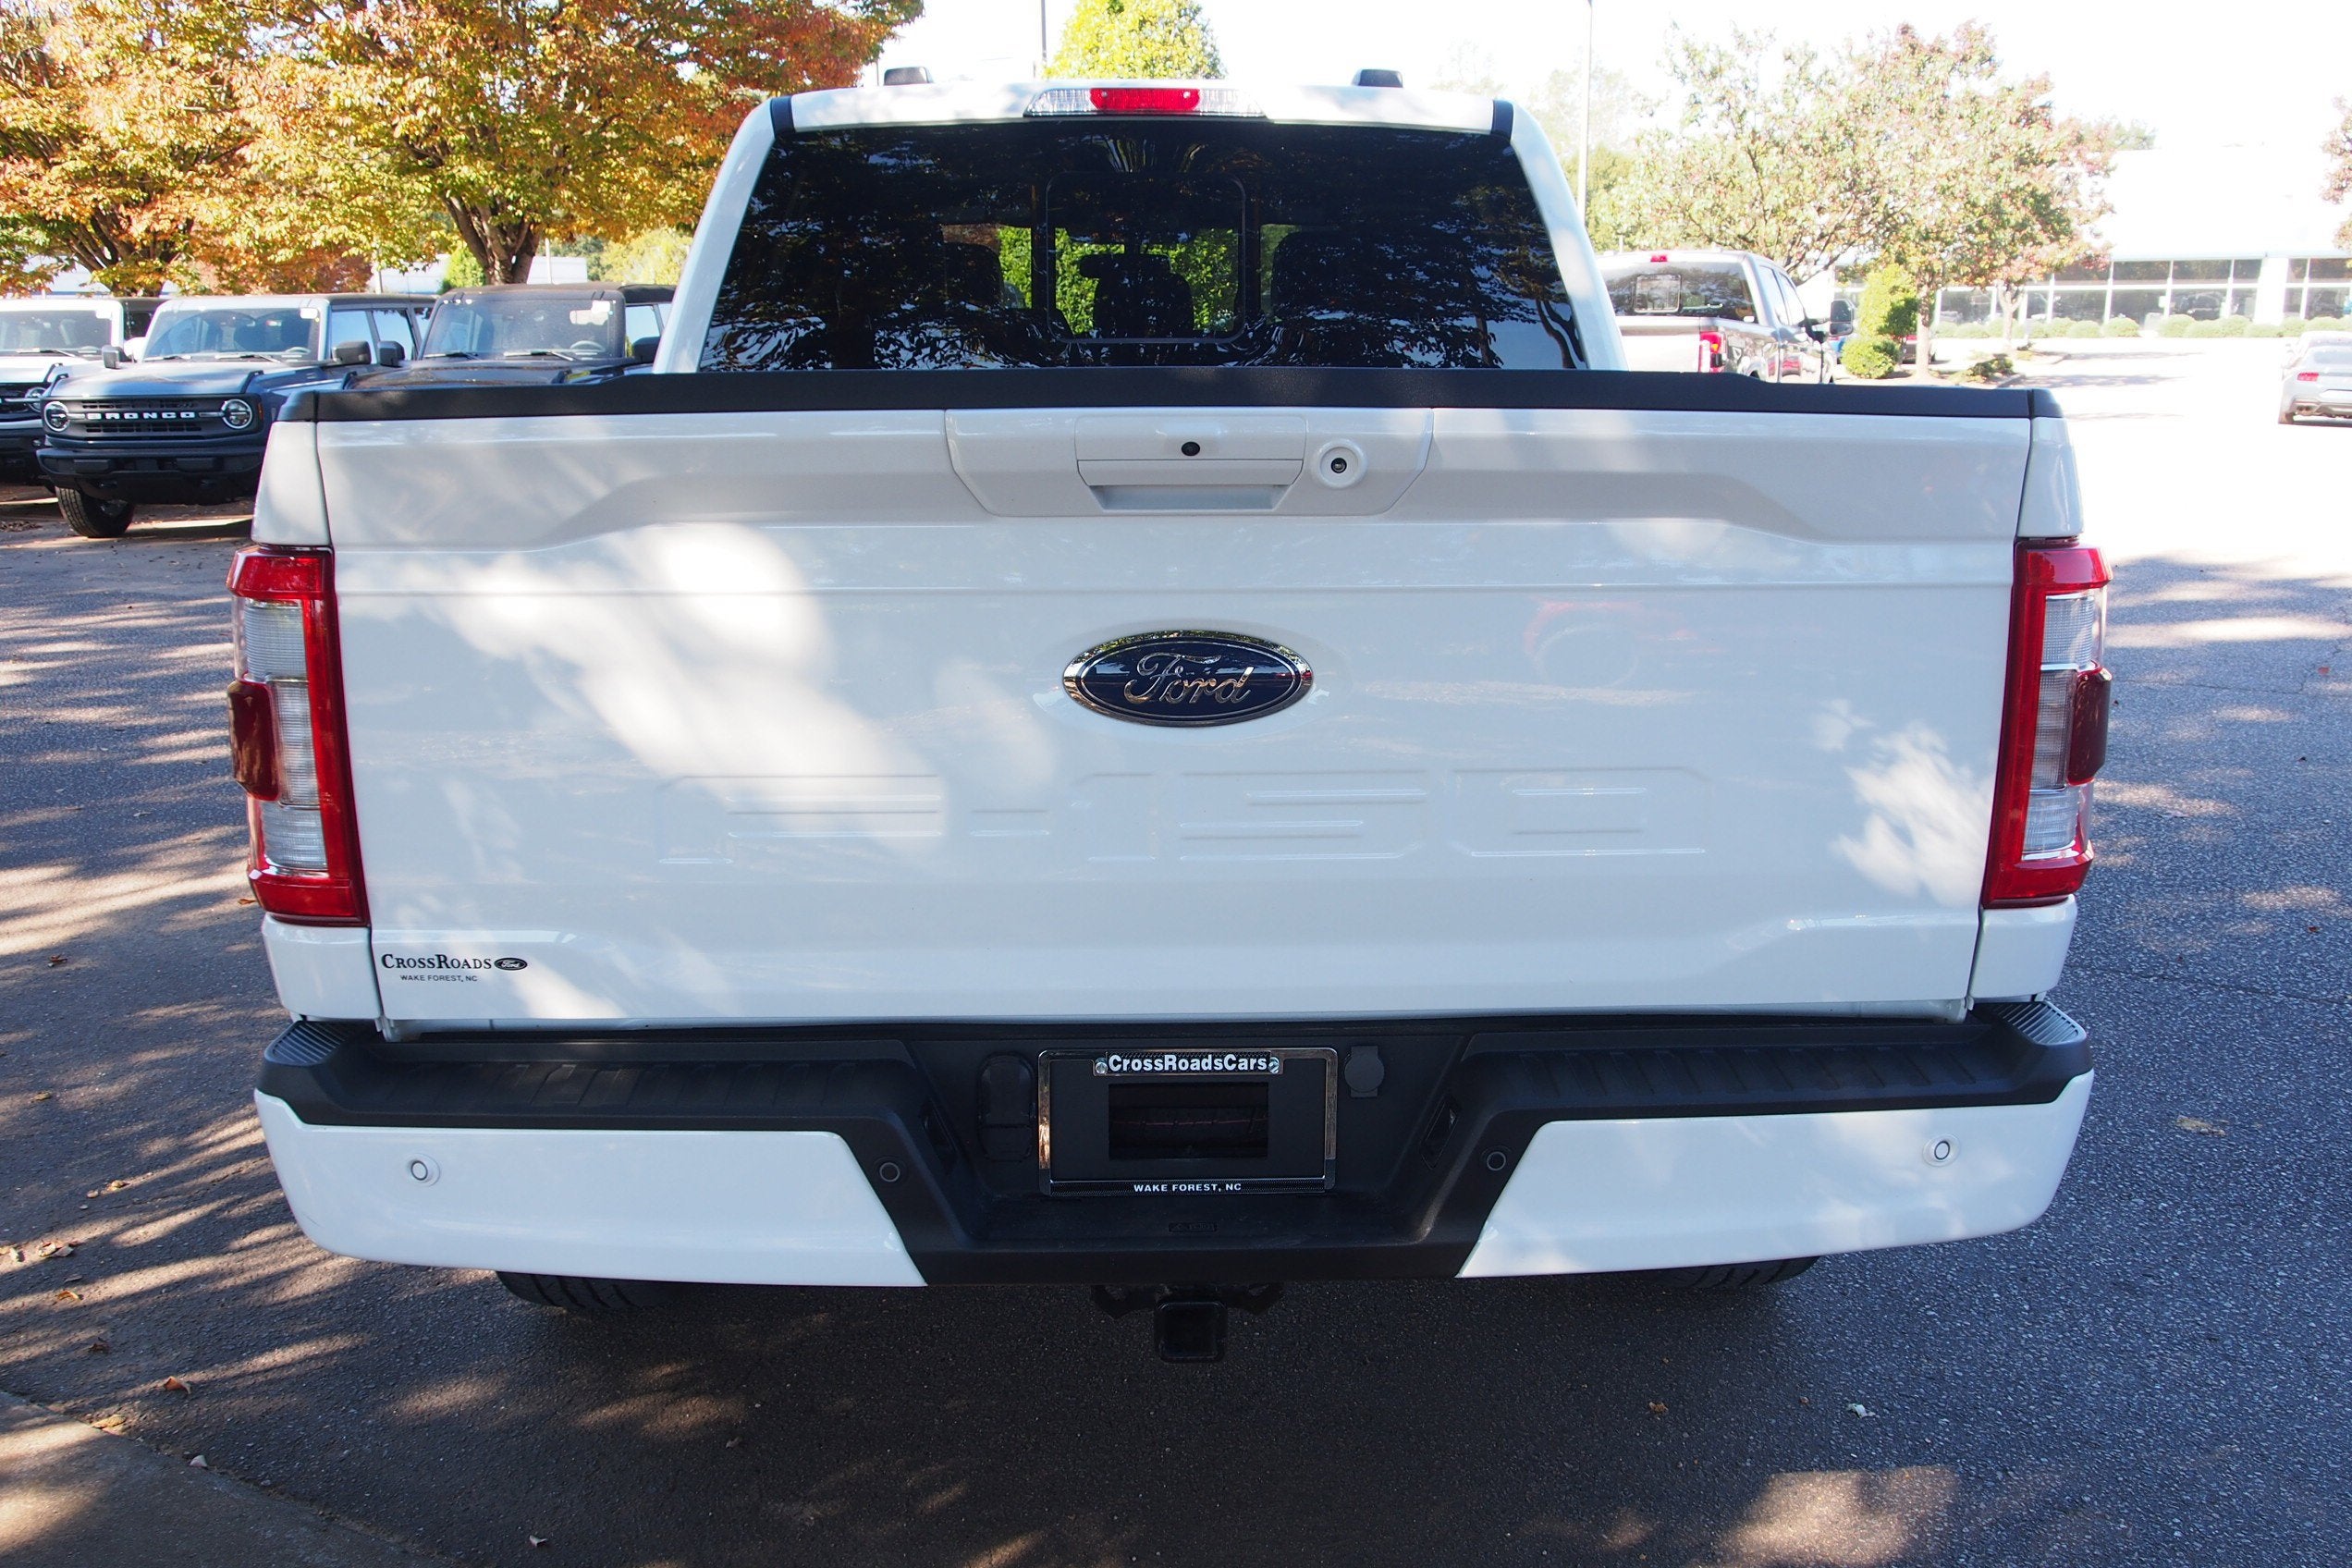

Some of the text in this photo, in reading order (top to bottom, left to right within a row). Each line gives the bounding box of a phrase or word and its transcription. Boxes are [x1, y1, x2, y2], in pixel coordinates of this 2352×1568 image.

[86, 410, 196, 421] BRONCO
[1123, 651, 1255, 704] Ford
[427, 974, 464, 983] FOREST,
[1109, 1053, 1268, 1072] CrossRoadsCars
[1133, 1182, 1242, 1193] WAKE FOREST, NC
